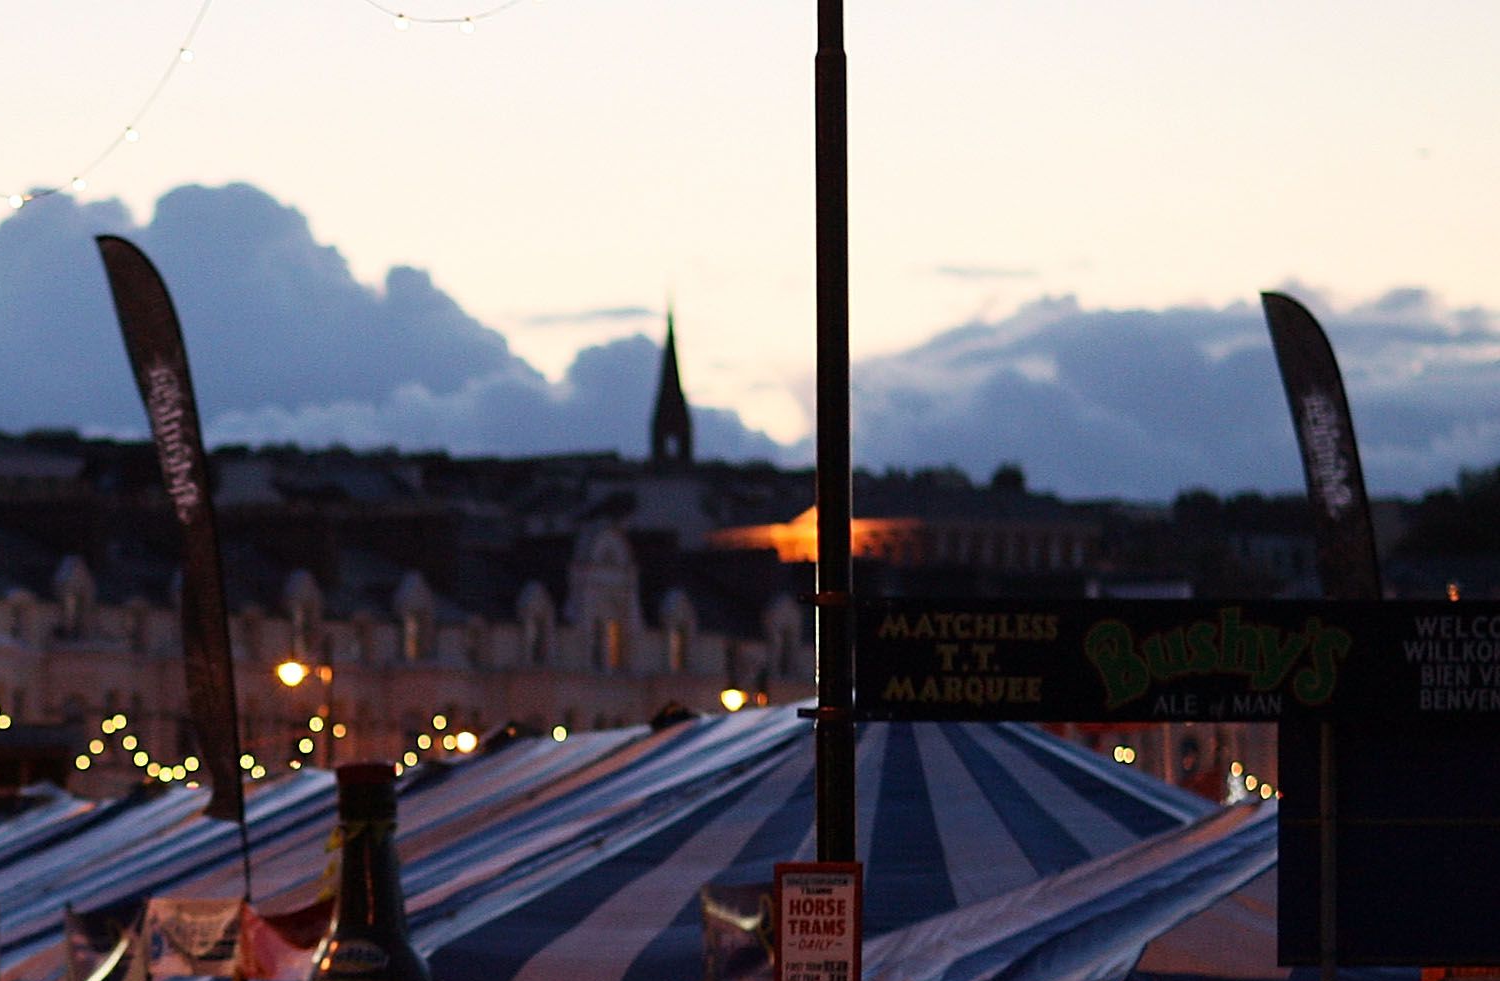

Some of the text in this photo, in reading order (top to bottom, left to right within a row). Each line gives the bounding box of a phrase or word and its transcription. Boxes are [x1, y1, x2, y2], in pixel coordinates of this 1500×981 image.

[879, 613, 1058, 639] MATCHLESS
[936, 643, 999, 671] T.T.
[1084, 606, 1352, 708] Bushy's
[1420, 664, 1471, 688] BIEN
[884, 676, 1043, 705] MARQUEE
[1153, 694, 1198, 715] ALE
[1232, 694, 1283, 715] MAN
[789, 898, 846, 916] HORSE
[788, 919, 845, 936] TRAMS
